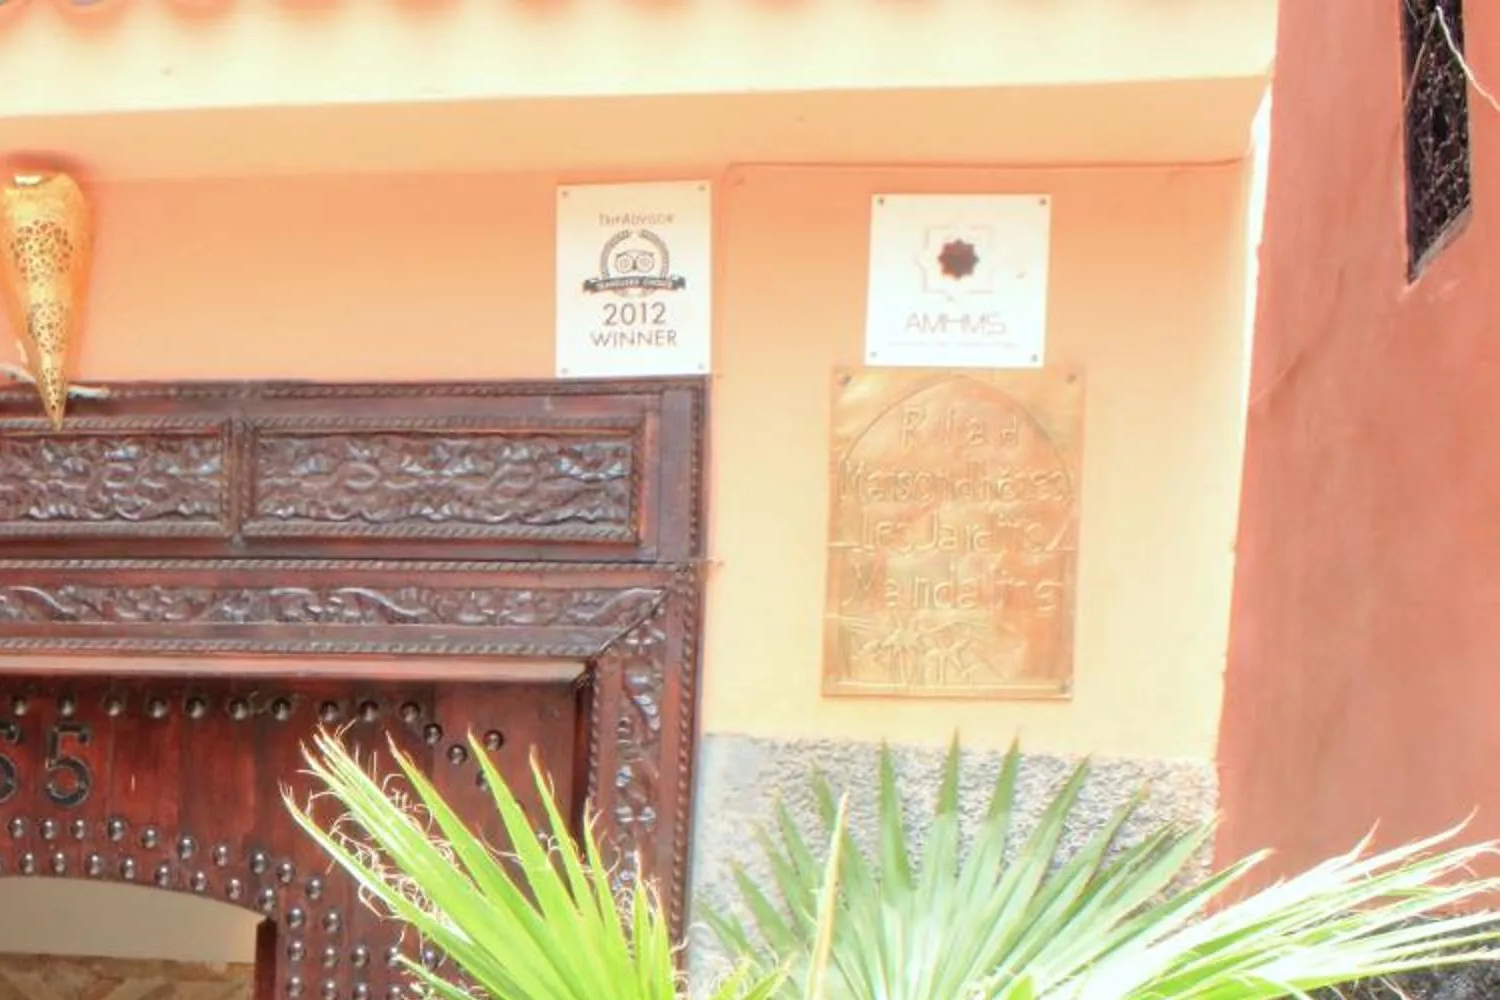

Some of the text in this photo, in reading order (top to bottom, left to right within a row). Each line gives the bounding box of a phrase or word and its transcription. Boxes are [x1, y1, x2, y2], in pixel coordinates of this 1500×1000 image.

[602, 301, 666, 326] 2012
[903, 311, 1007, 336] AMHMS
[589, 327, 678, 347] WINNER
